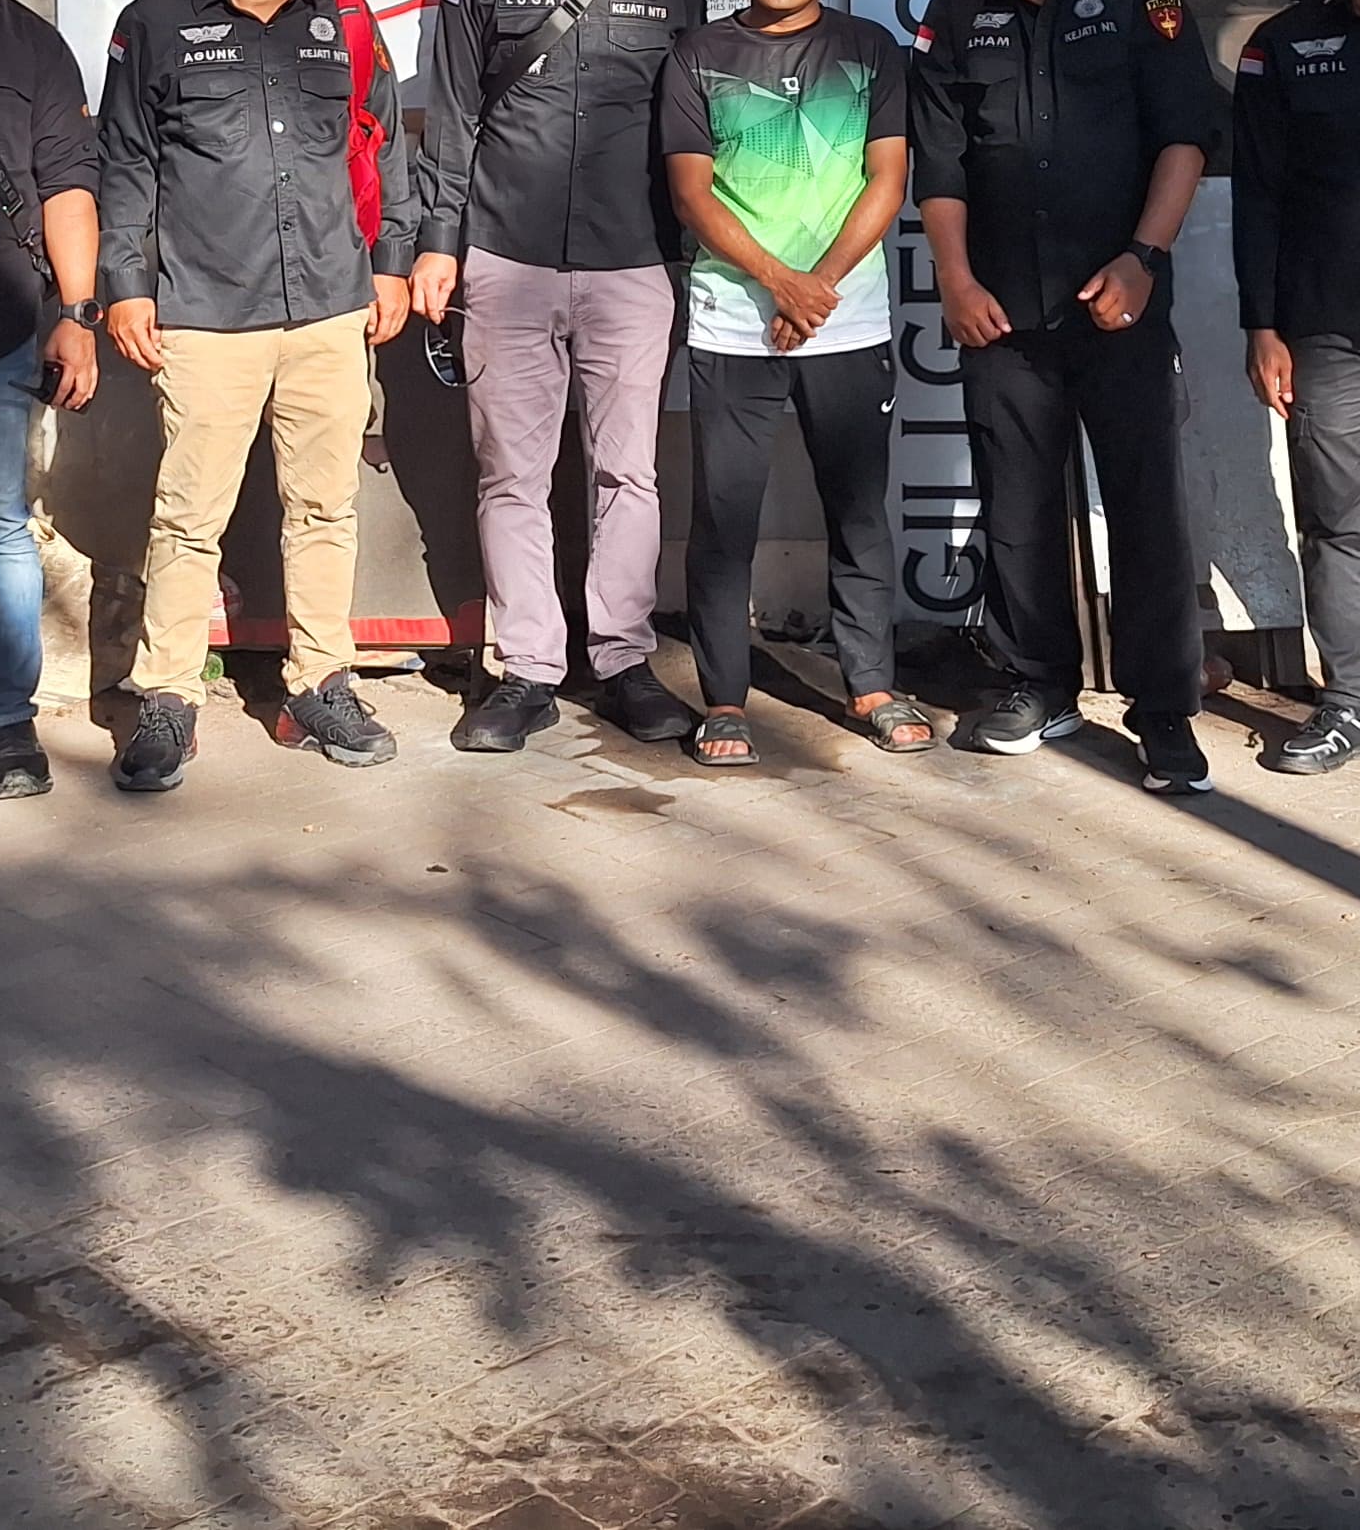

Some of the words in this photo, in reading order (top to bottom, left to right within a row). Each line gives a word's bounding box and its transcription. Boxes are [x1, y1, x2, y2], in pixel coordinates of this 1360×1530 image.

[612, 2, 645, 17] KEJATI
[648, 6, 667, 19] NTB
[1064, 25, 1097, 42] KEJATI
[183, 48, 238, 64] AGUNK
[299, 49, 332, 61] KEJATI
[1296, 61, 1347, 76] HERIL
